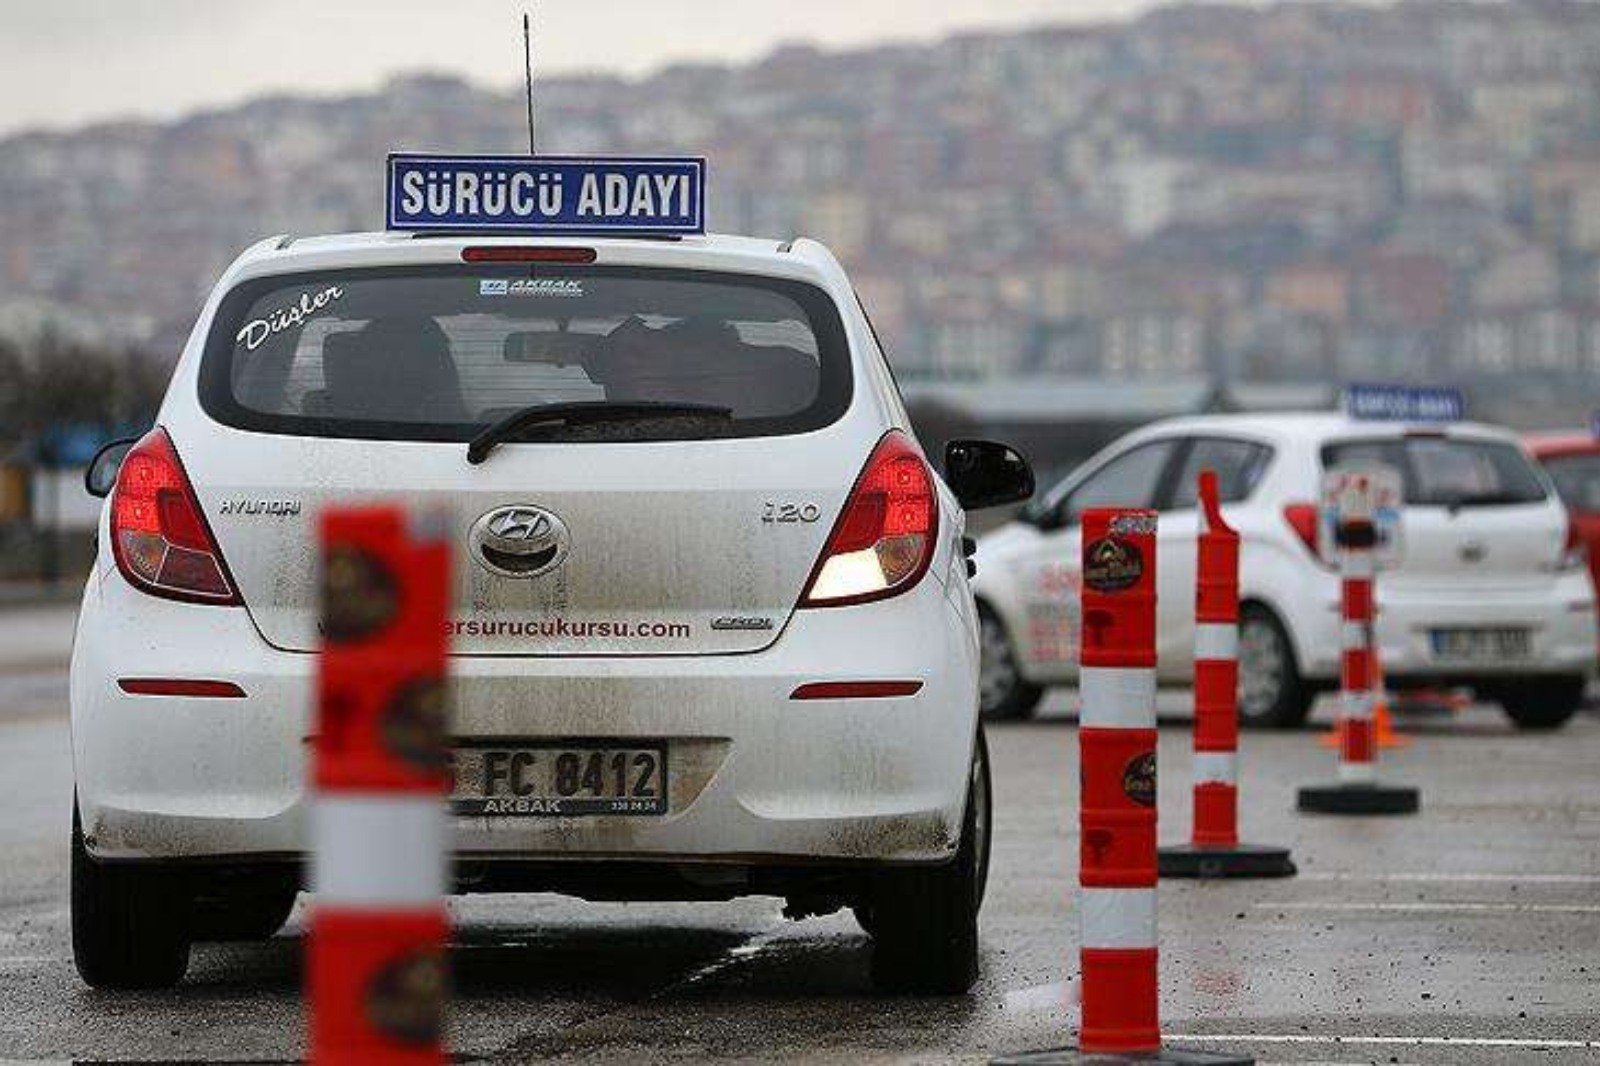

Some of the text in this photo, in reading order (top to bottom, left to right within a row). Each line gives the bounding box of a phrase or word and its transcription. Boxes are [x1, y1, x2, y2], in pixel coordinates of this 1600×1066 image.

[401, 170, 691, 217] SÜRÜCÜ ADAYI
[236, 285, 344, 350] Düşler
[317, 617, 691, 639] ersurucukursu.com
[482, 751, 656, 797] FC 8412
[483, 799, 562, 813] AKBAK
